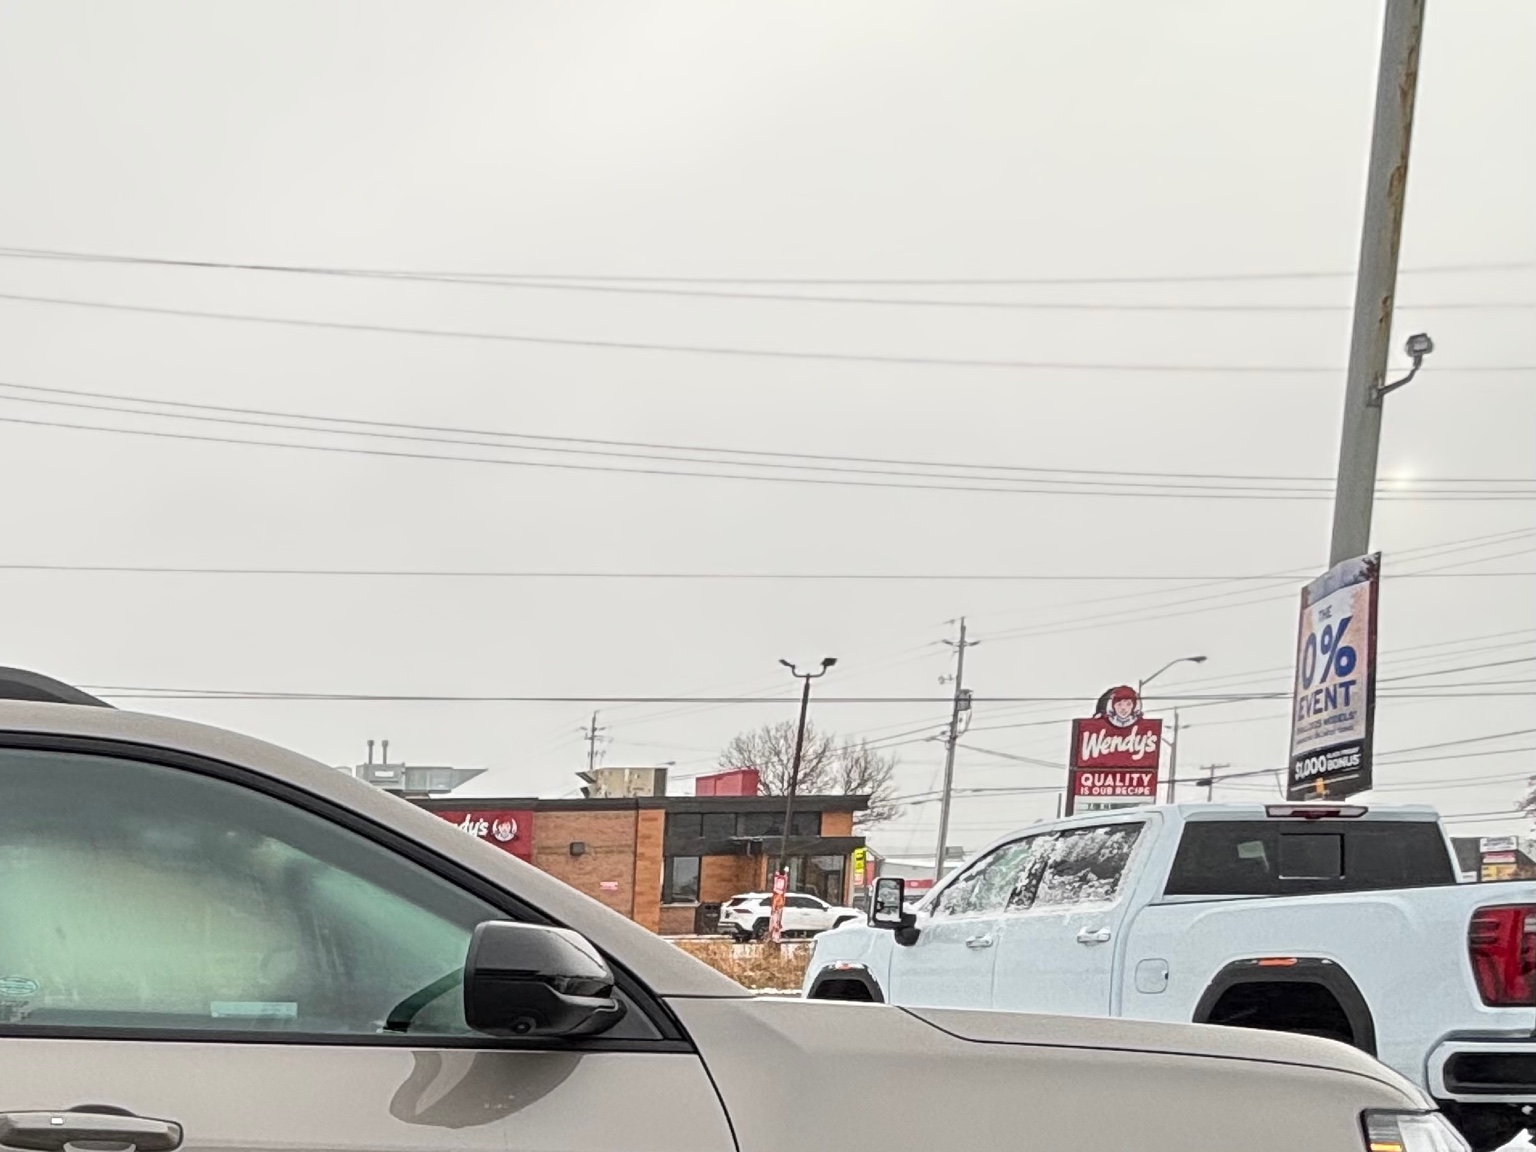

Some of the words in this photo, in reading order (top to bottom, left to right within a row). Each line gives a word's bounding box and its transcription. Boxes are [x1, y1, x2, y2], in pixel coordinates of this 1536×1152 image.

[1318, 605, 1333, 622] THE
[1301, 615, 1357, 691] 0%
[1297, 679, 1357, 722] EVENT
[1082, 725, 1158, 761] Wendy's
[1080, 773, 1153, 787] QUALITY
[1080, 786, 1090, 795] IS
[1092, 786, 1113, 795] OUR
[1115, 786, 1151, 795] RECIPE
[456, 814, 489, 837] dy's
